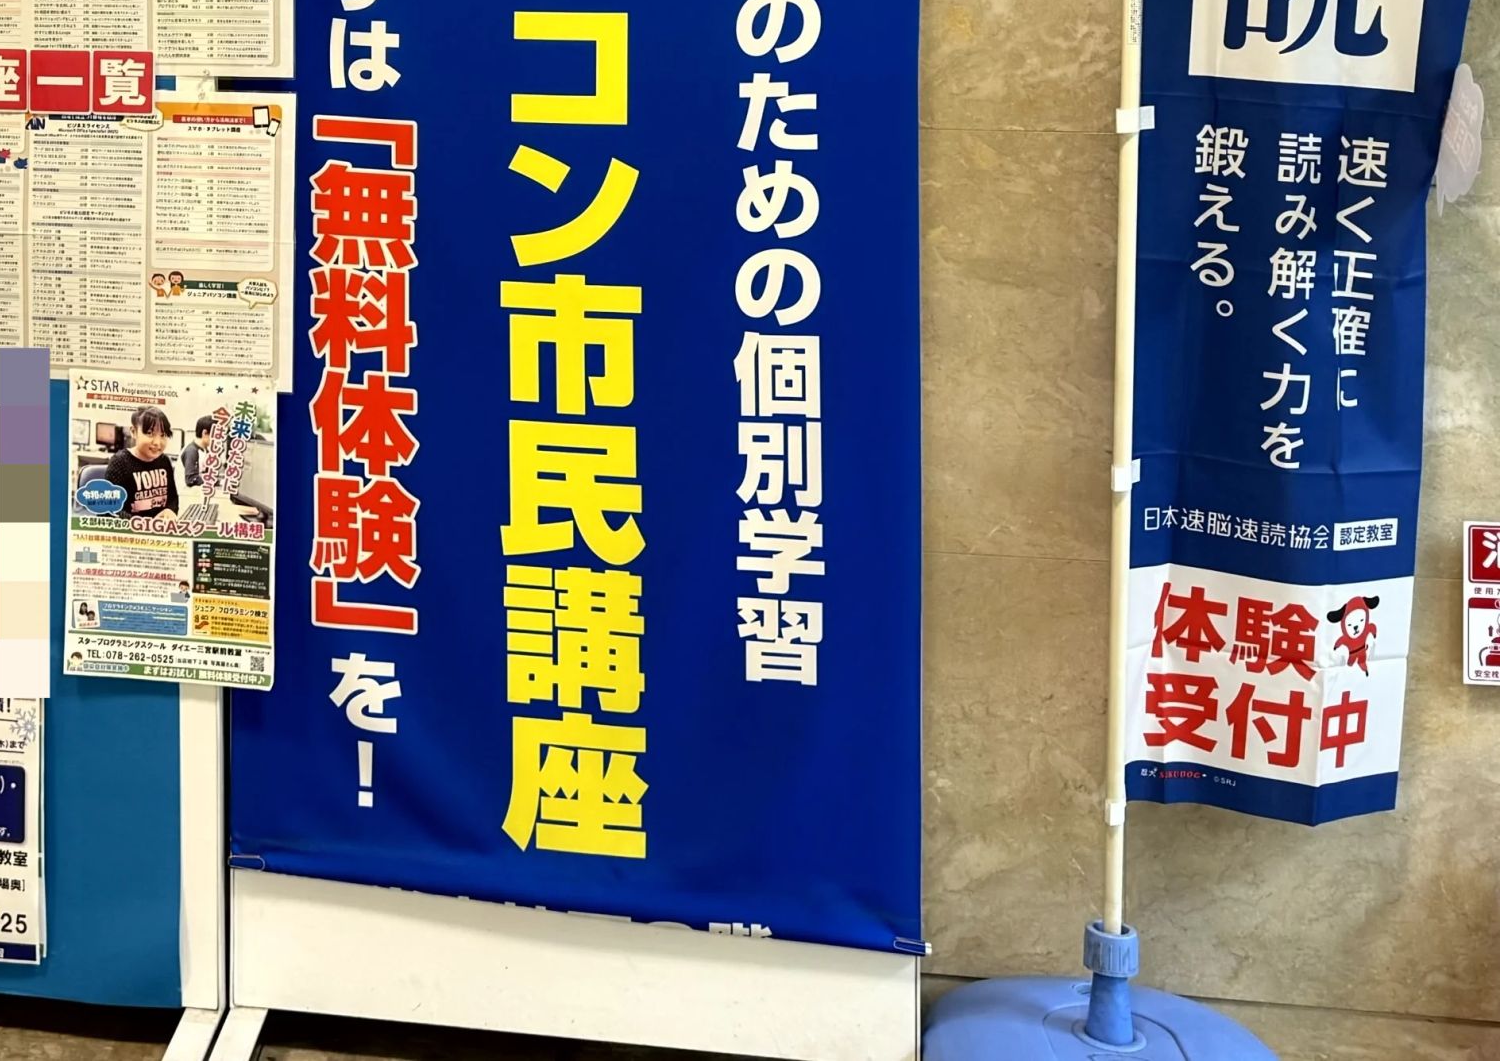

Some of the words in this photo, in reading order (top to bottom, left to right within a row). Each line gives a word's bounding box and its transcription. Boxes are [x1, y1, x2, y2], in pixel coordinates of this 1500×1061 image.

[1190, 123, 1248, 318] 鍛える。
[1260, 131, 1324, 470] 読み解く力を
[91, 380, 119, 392] STAR
[158, 390, 179, 398] SCHOOL
[133, 469, 168, 486] YOUR
[202, 406, 230, 511] 今はじめよう!
[224, 401, 256, 495] 未来のために
[1144, 506, 1329, 552] 日本速脳速読協会
[1340, 522, 1395, 546] 認定教室
[78, 637, 166, 650] スタープログラミングスクール
[172, 643, 242, 656] ダイエー三宮駅前教室
[88, 649, 174, 663] TEL:078-262-0525
[1152, 580, 1320, 682] 体験
[1143, 673, 1368, 769] 受付中
